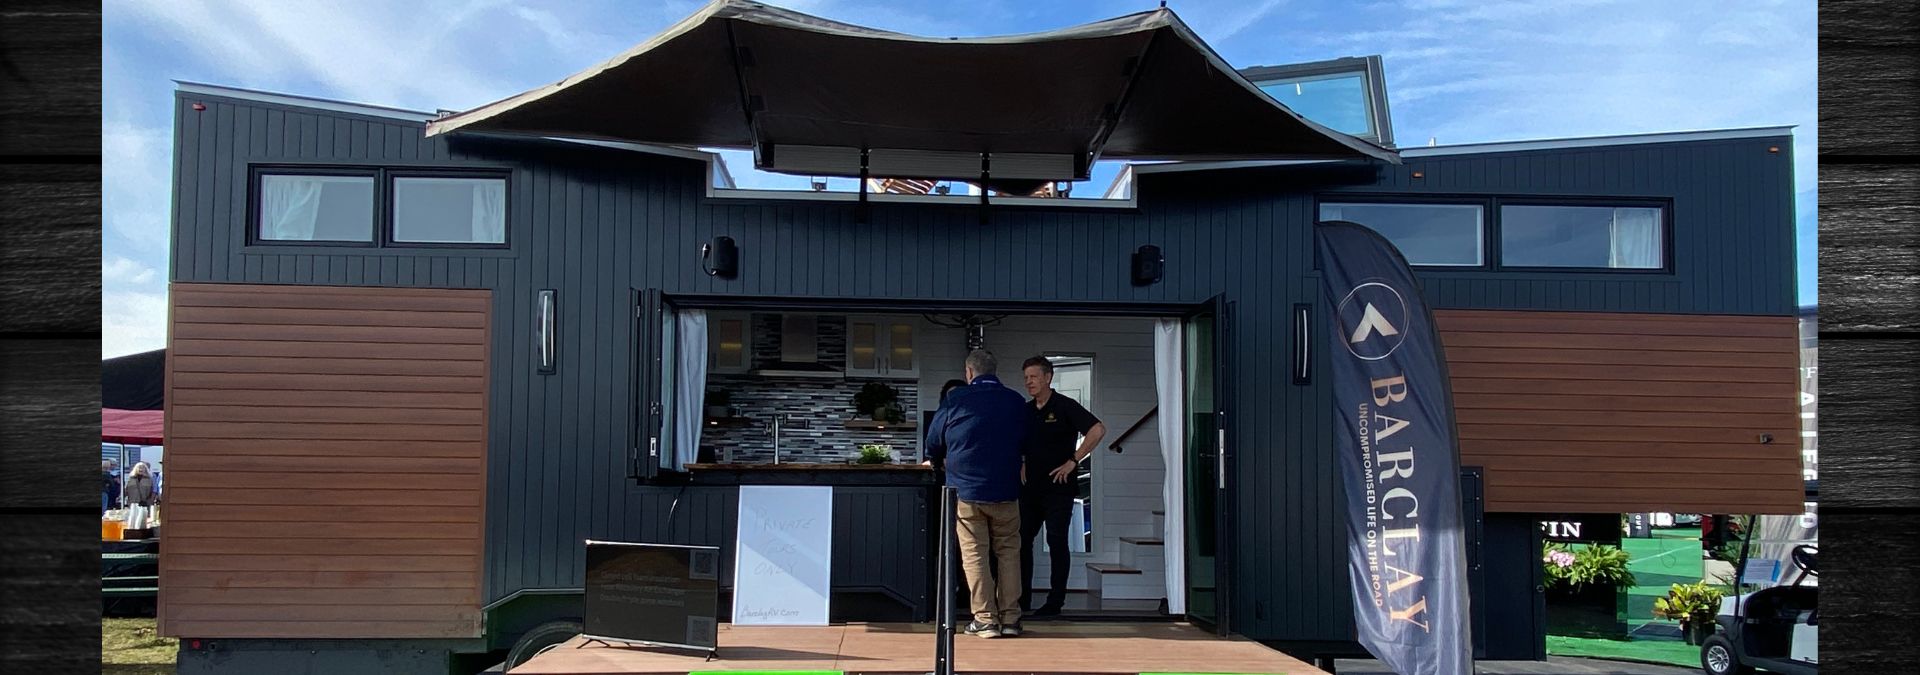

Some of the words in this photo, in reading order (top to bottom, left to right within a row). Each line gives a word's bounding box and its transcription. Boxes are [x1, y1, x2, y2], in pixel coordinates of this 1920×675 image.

[1359, 403, 1376, 504] UNCOMPROMISED
[1370, 371, 1429, 633] BARCLAY
[1366, 506, 1377, 528] LIFE
[1367, 530, 1377, 548] ON
[1368, 550, 1379, 572] THE
[1371, 574, 1384, 608] ROAD
